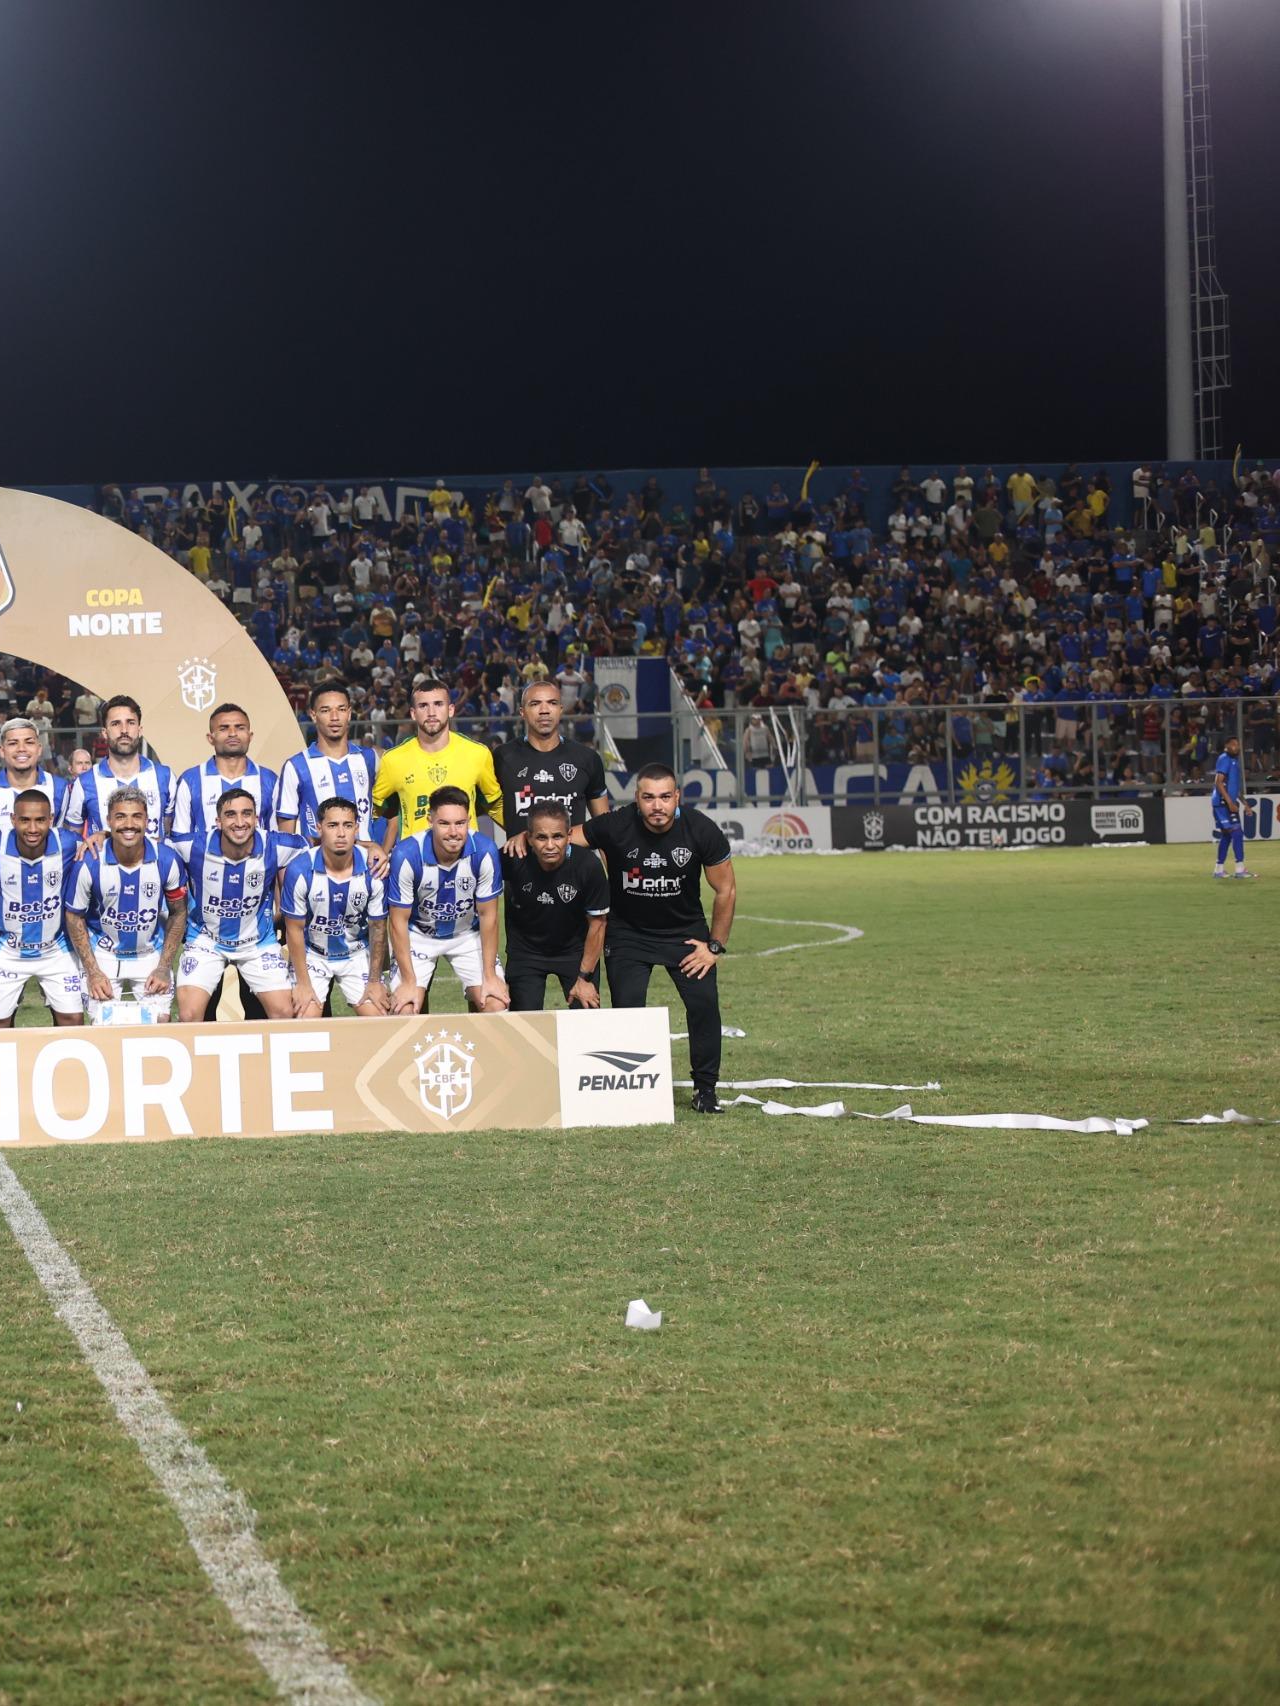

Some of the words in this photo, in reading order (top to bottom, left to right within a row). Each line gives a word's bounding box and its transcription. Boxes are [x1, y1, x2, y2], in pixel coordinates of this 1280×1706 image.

[85, 588, 144, 608] COPA
[68, 611, 163, 637] NORTE
[914, 806, 963, 826] COM
[967, 803, 1066, 825] RACISMO
[1212, 797, 1273, 839] il
[1120, 818, 1140, 829] 100
[917, 826, 961, 847] NÃO
[968, 828, 1011, 846] TEM
[1013, 826, 1066, 845] JOGO
[9, 901, 41, 913] Bet
[208, 895, 240, 909] Bet
[422, 899, 454, 914] Bet
[18, 912, 55, 923] Sorte
[106, 907, 137, 922] Bet
[216, 909, 253, 918] Sorte
[431, 911, 468, 921] Sorte
[114, 921, 150, 932] Sorte
[435, 1074, 456, 1083] CBF
[578, 1073, 661, 1091] PENALTY
